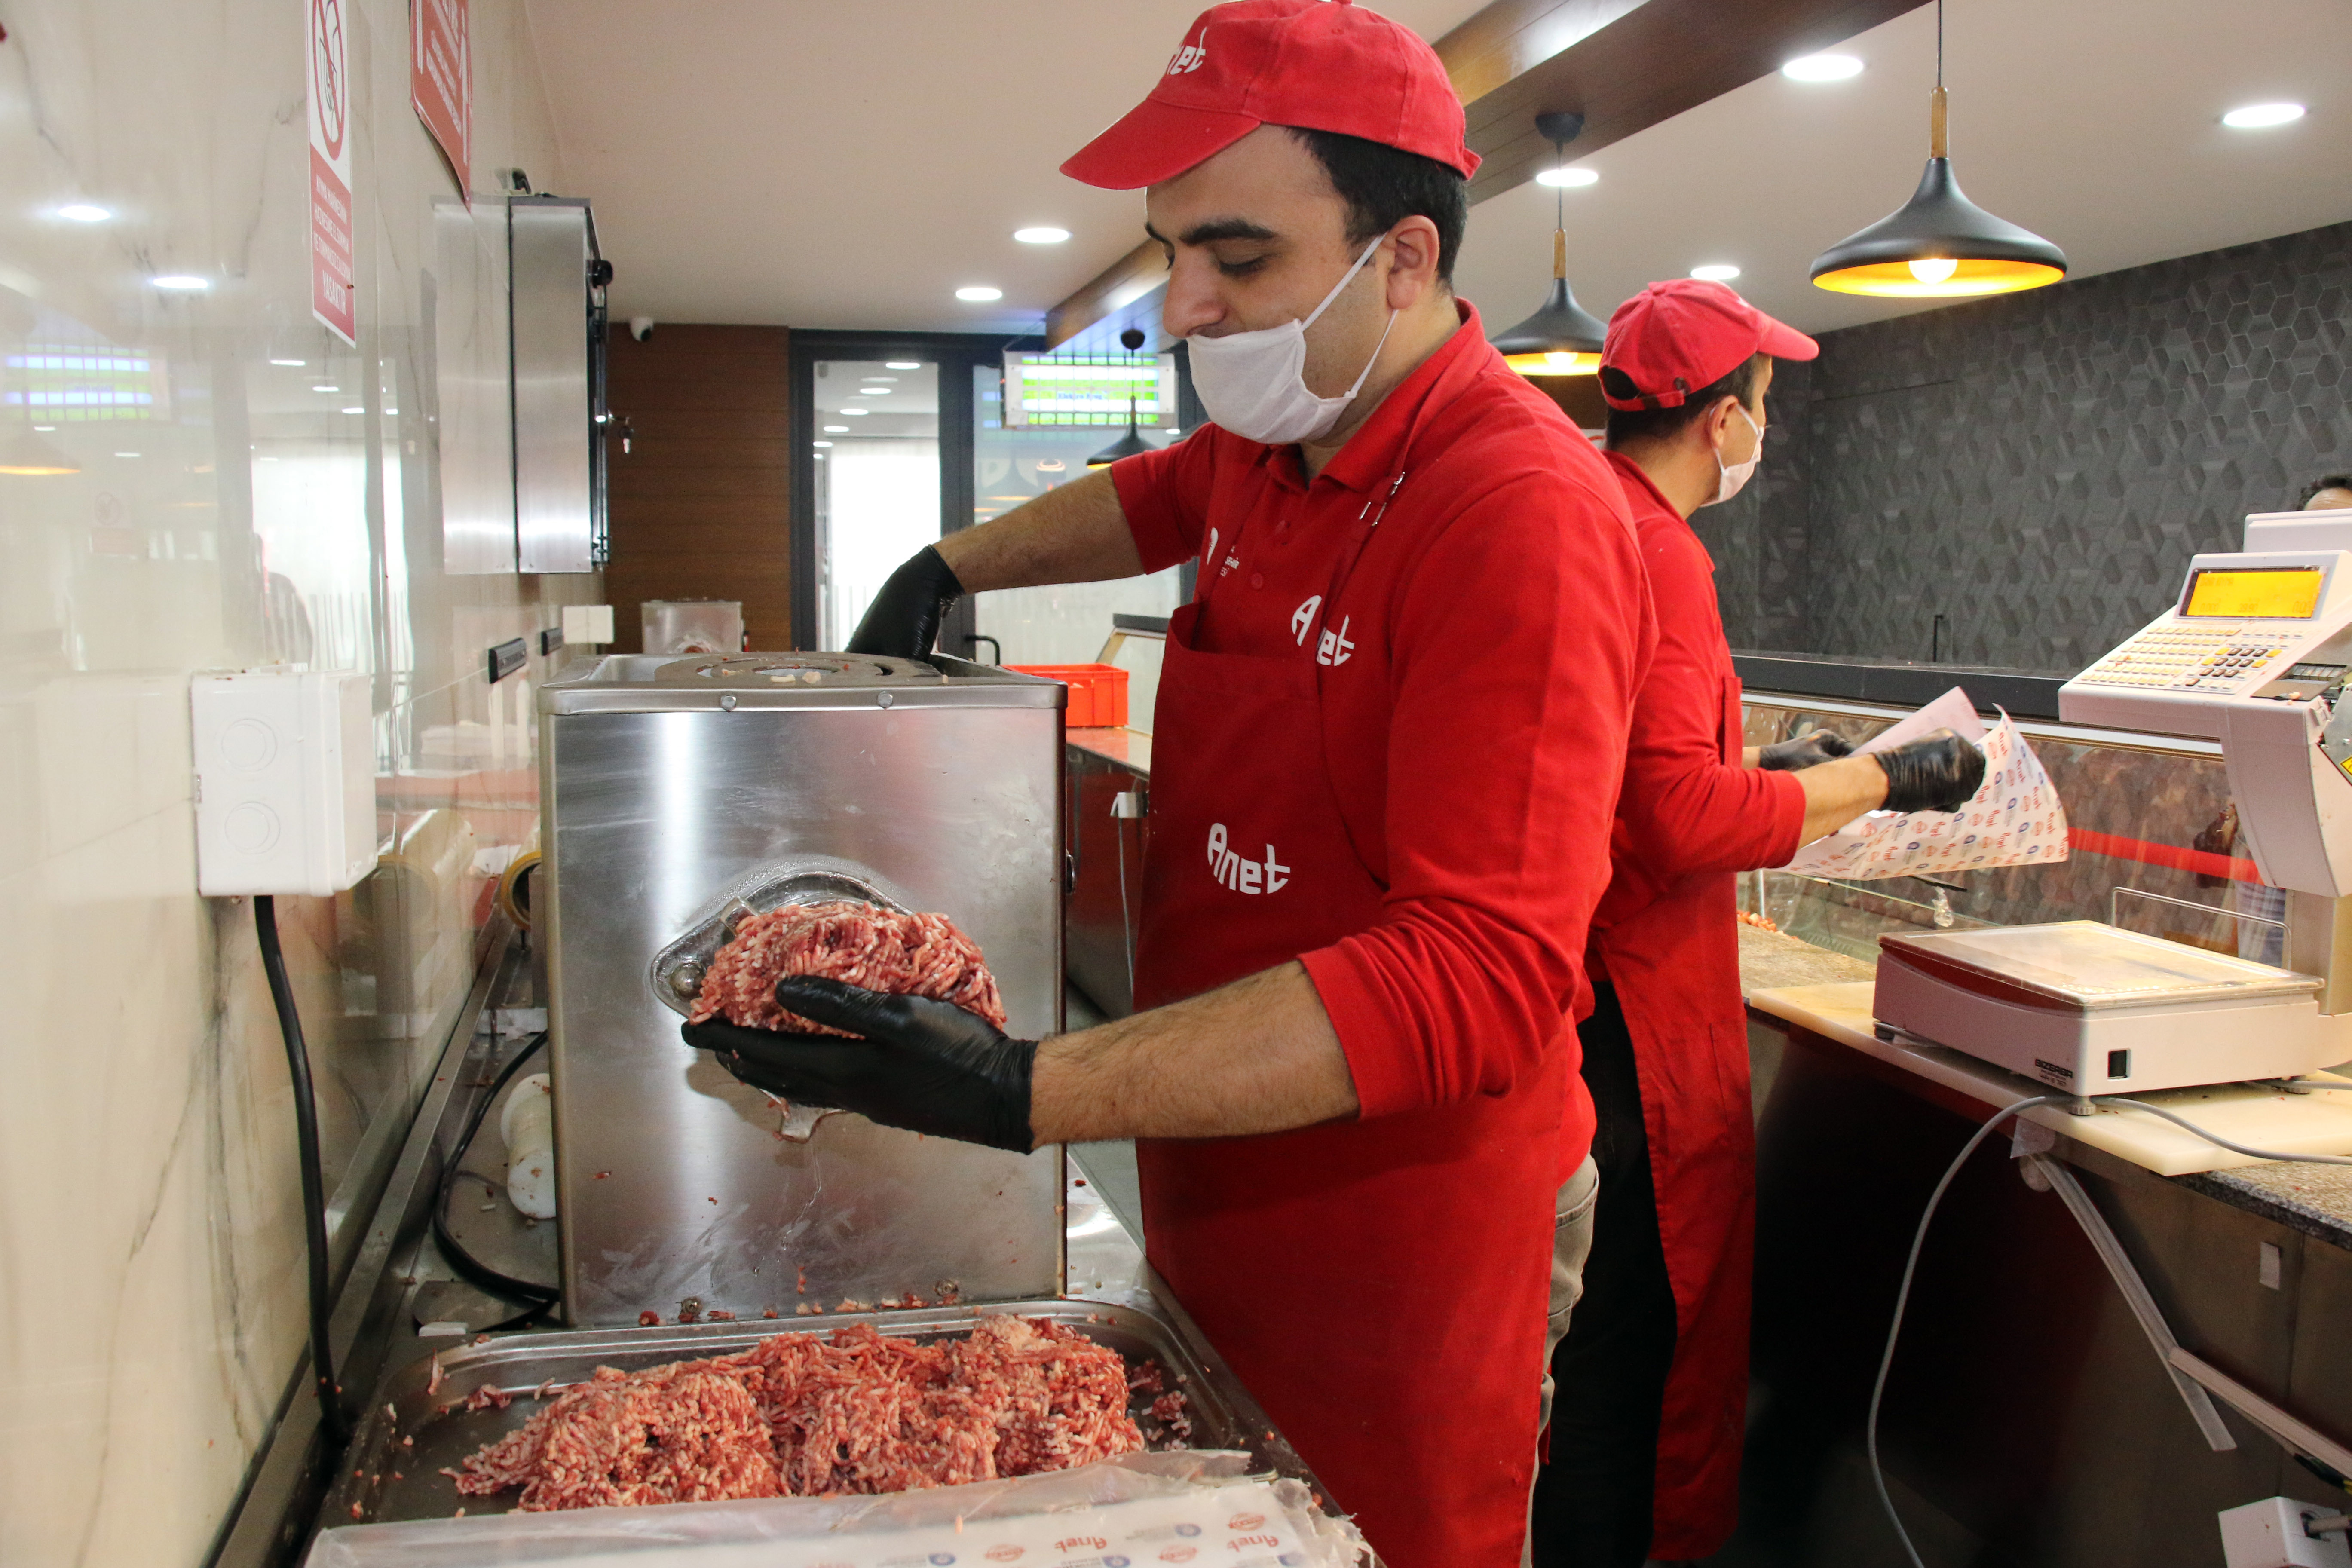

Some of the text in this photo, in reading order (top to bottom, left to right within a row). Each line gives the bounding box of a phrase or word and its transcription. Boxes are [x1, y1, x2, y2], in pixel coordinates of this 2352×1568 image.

[1292, 595, 1354, 666] Aet
[1207, 823, 1290, 895] Anet
[2035, 1059, 2073, 1078] BIZERBA
[1054, 1536, 1107, 1553] Anet
[1227, 1535, 1279, 1553] Anet
